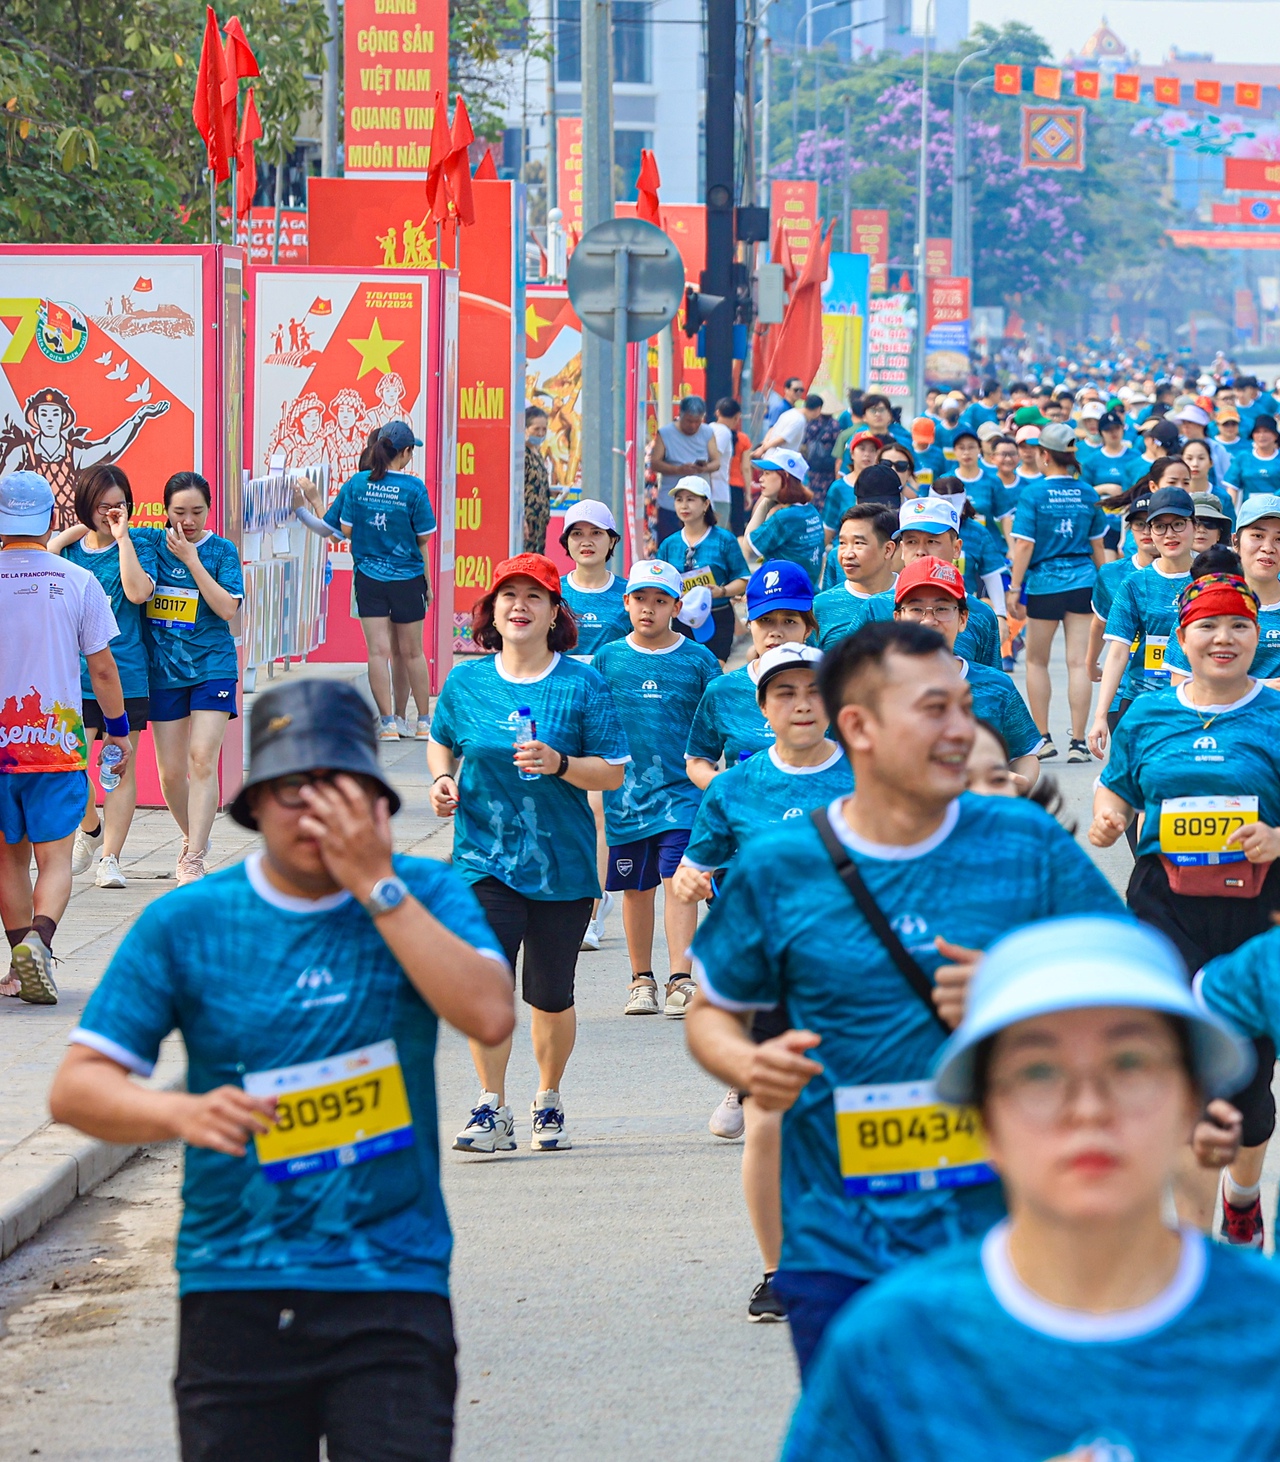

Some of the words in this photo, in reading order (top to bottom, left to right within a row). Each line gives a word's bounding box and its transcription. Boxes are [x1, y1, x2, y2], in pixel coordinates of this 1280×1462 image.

[357, 25, 398, 57] CỘNG
[402, 23, 434, 52] SẢN
[360, 64, 391, 95] VIỆT
[395, 69, 430, 91] NAM
[351, 107, 400, 131] QUANG
[348, 141, 393, 168] MUÔN
[460, 381, 504, 420] NĂM
[366, 491, 399, 500] MARATHON
[367, 482, 400, 493] THACO
[20, 571, 66, 579] FRANCOPHONIE
[454, 556, 492, 591] 024)
[154, 598, 187, 612] 80117
[857, 1110, 976, 1149] 80434
